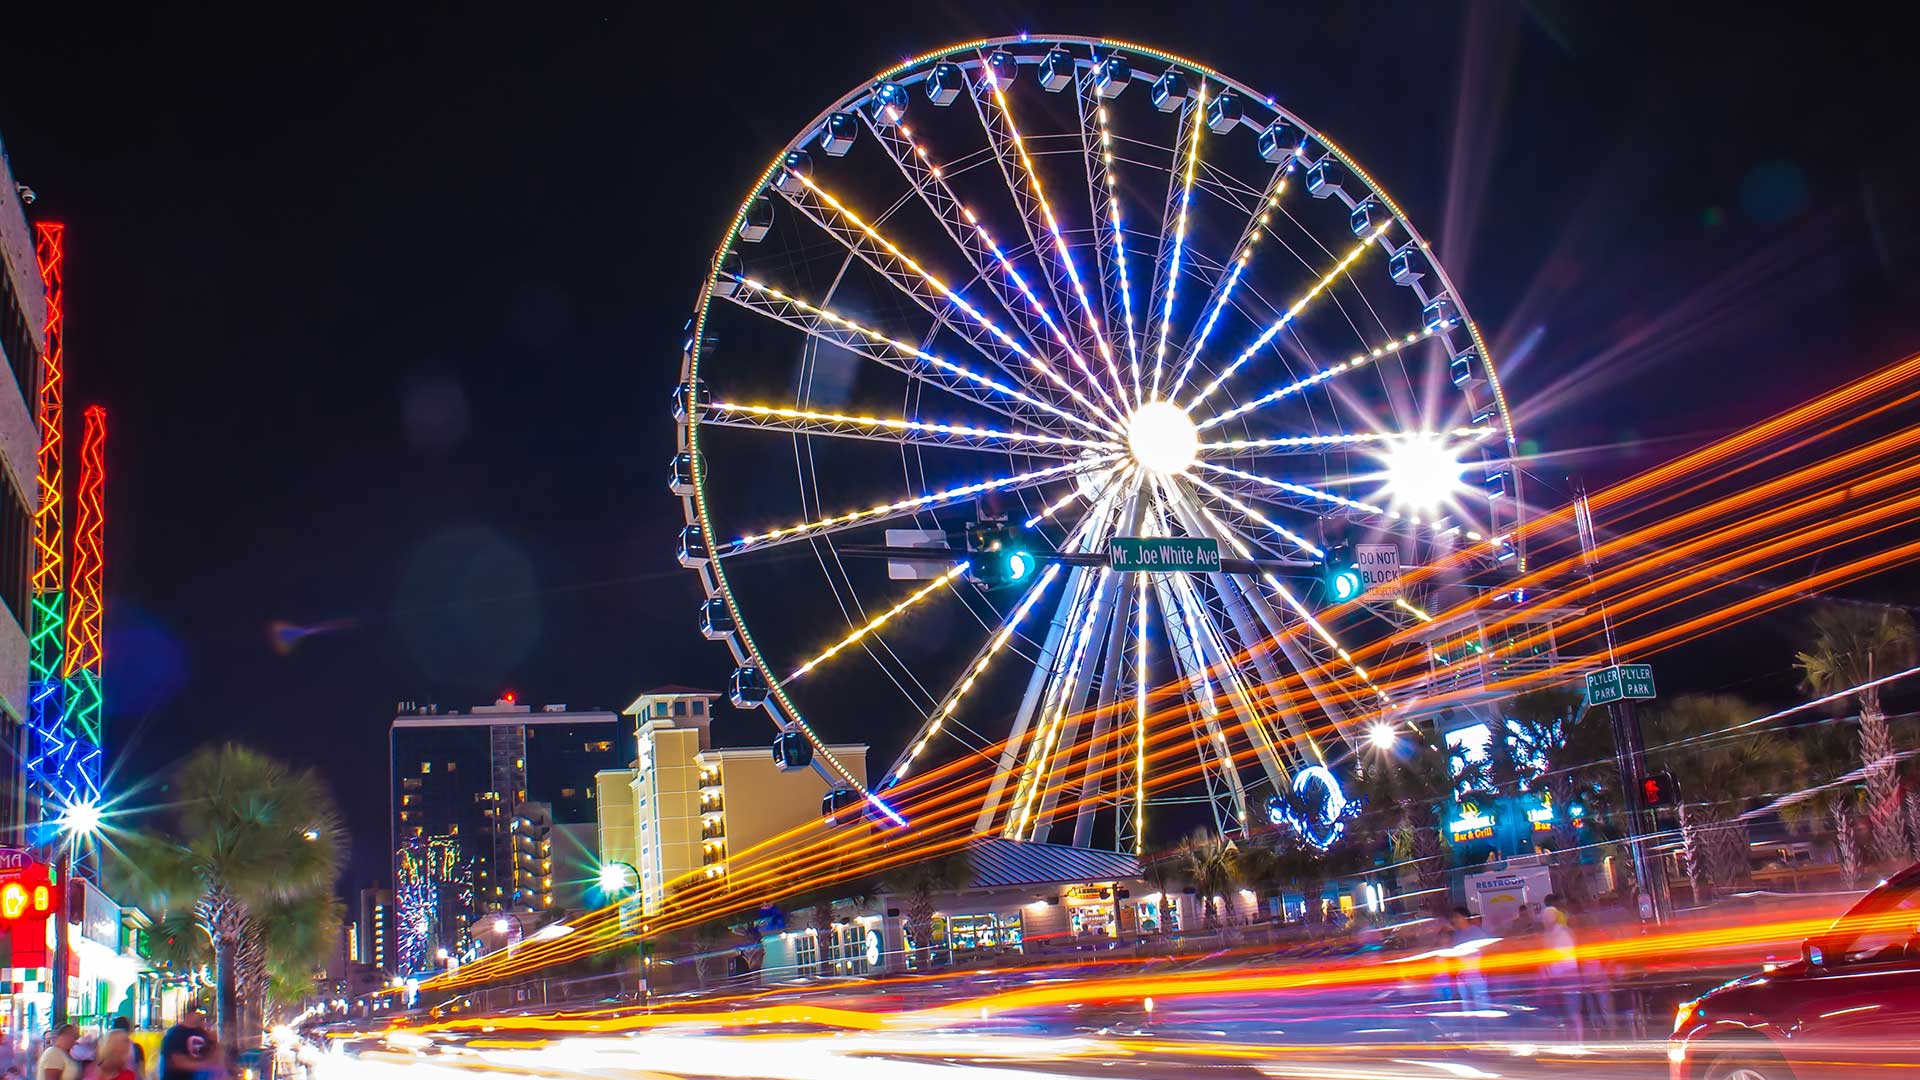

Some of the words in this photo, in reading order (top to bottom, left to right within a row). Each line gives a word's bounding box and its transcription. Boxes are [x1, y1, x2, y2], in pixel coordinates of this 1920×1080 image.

[1112, 545, 1132, 565] Mr.
[1135, 545, 1158, 565] Joe
[1159, 545, 1194, 565] White
[1196, 545, 1218, 565] Ave
[1359, 552, 1375, 565] DO
[1376, 551, 1396, 565] NOT
[1362, 570, 1399, 584] BLOCK
[1589, 670, 1617, 686] PLYLER
[1621, 669, 1650, 679] PLYLER
[1595, 687, 1616, 700] PARK
[1627, 684, 1650, 695] PARK
